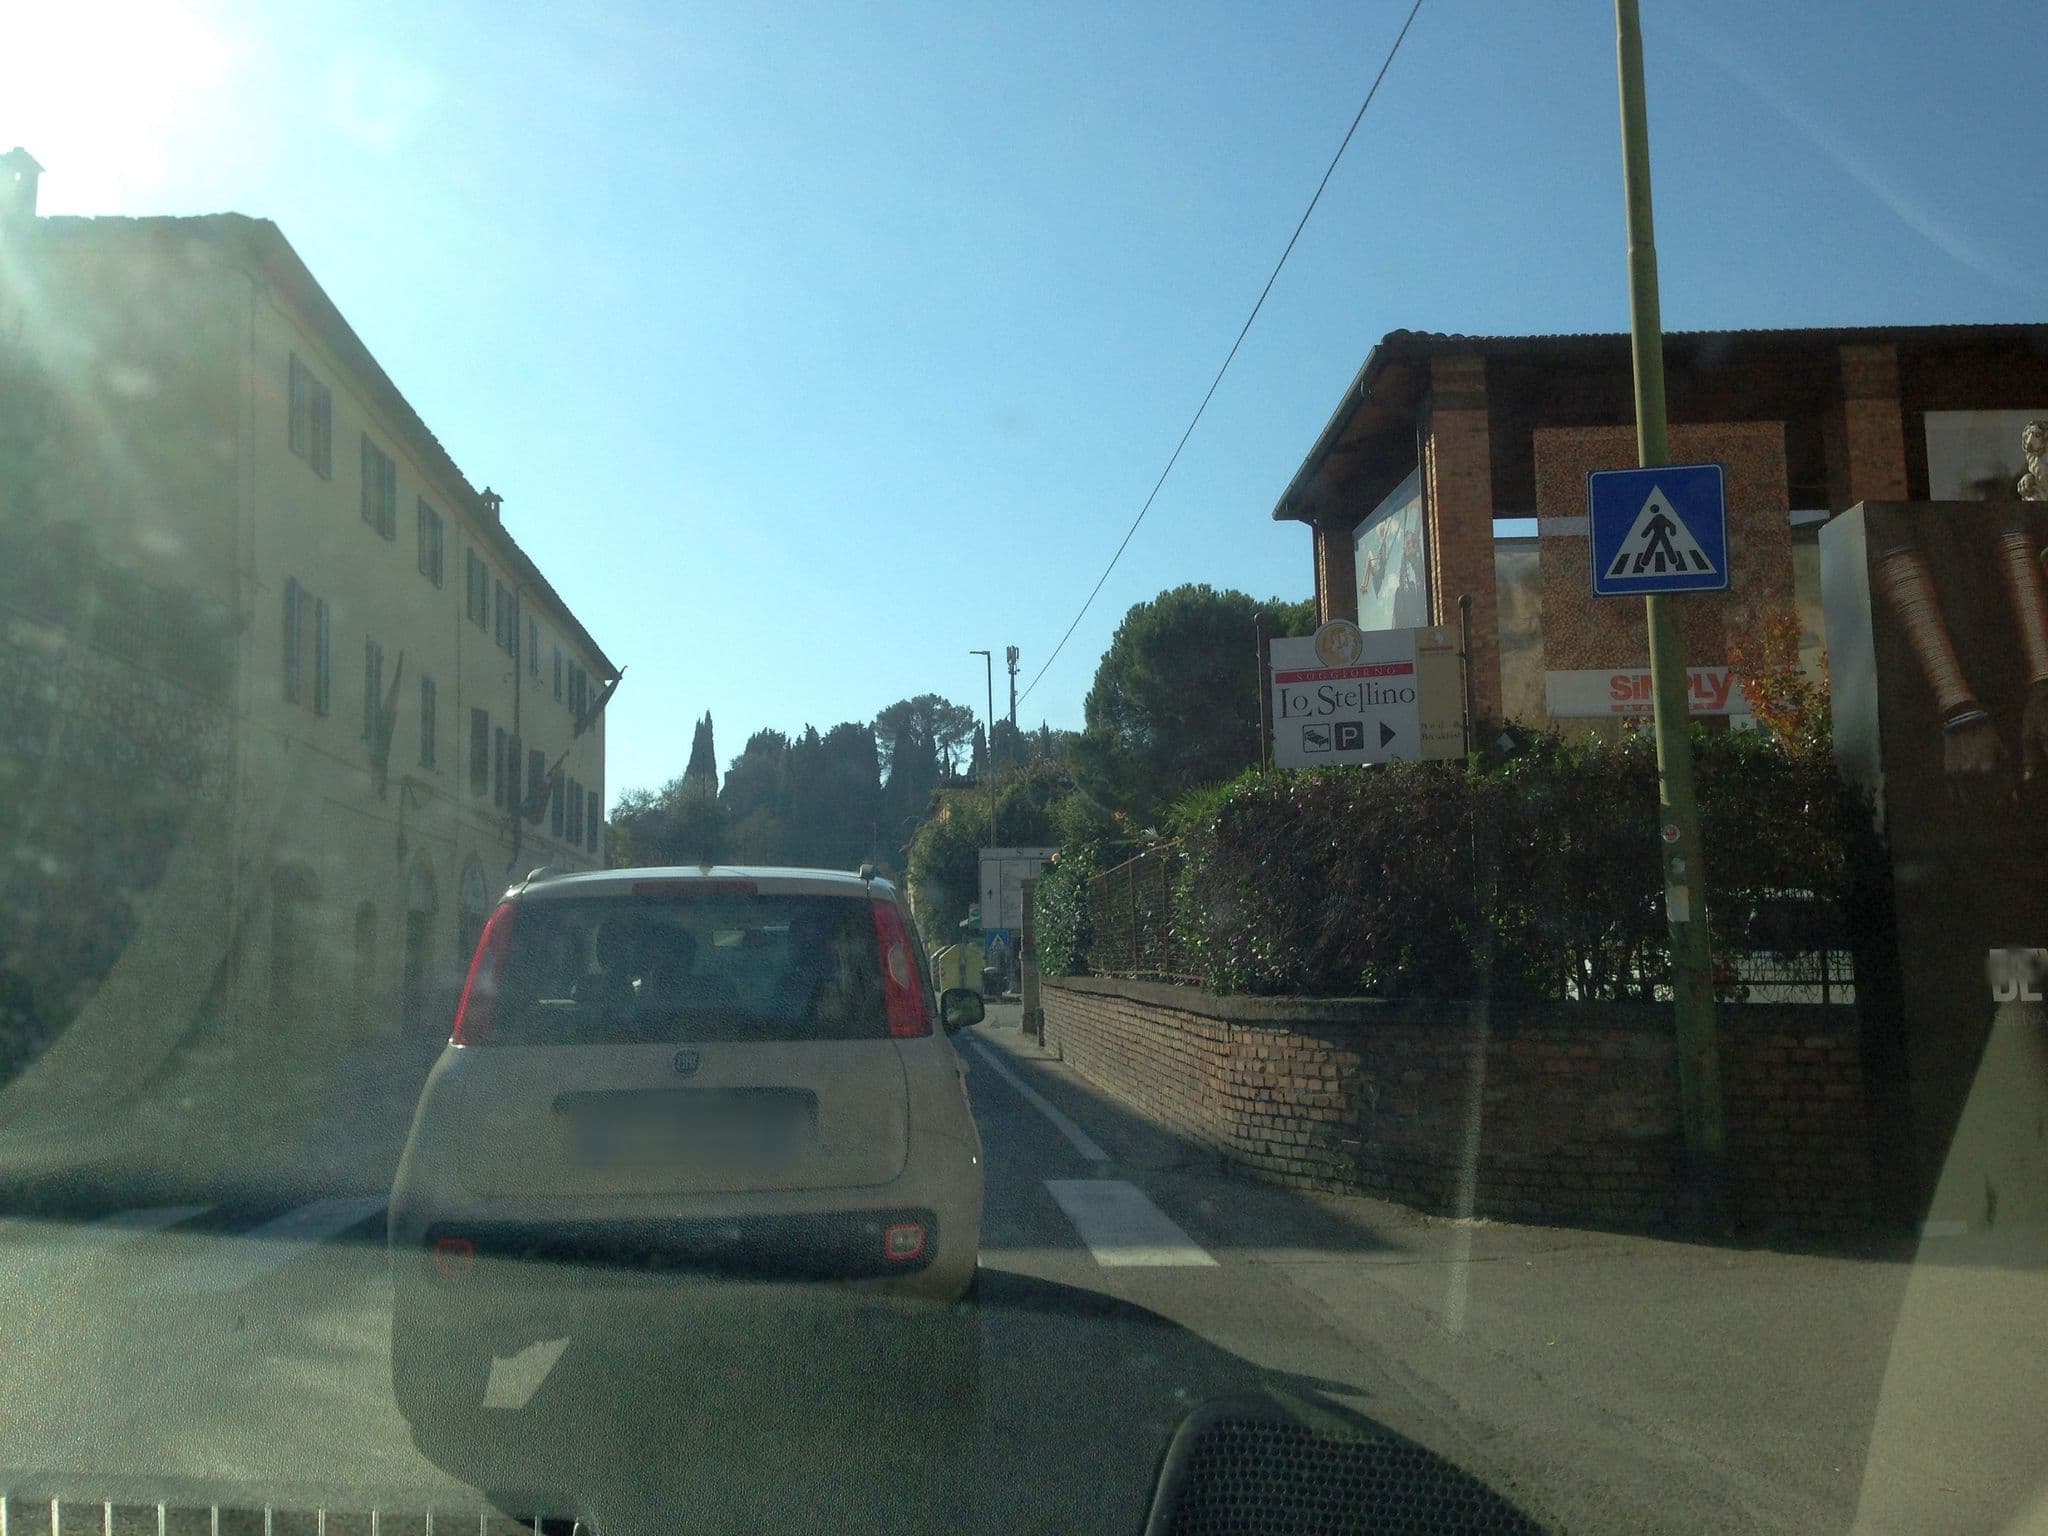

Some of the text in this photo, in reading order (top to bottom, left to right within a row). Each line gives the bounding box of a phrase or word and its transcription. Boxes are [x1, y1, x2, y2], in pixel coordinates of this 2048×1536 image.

[1280, 682, 1416, 719] Lo Stellino
[1343, 726, 1358, 748] P
